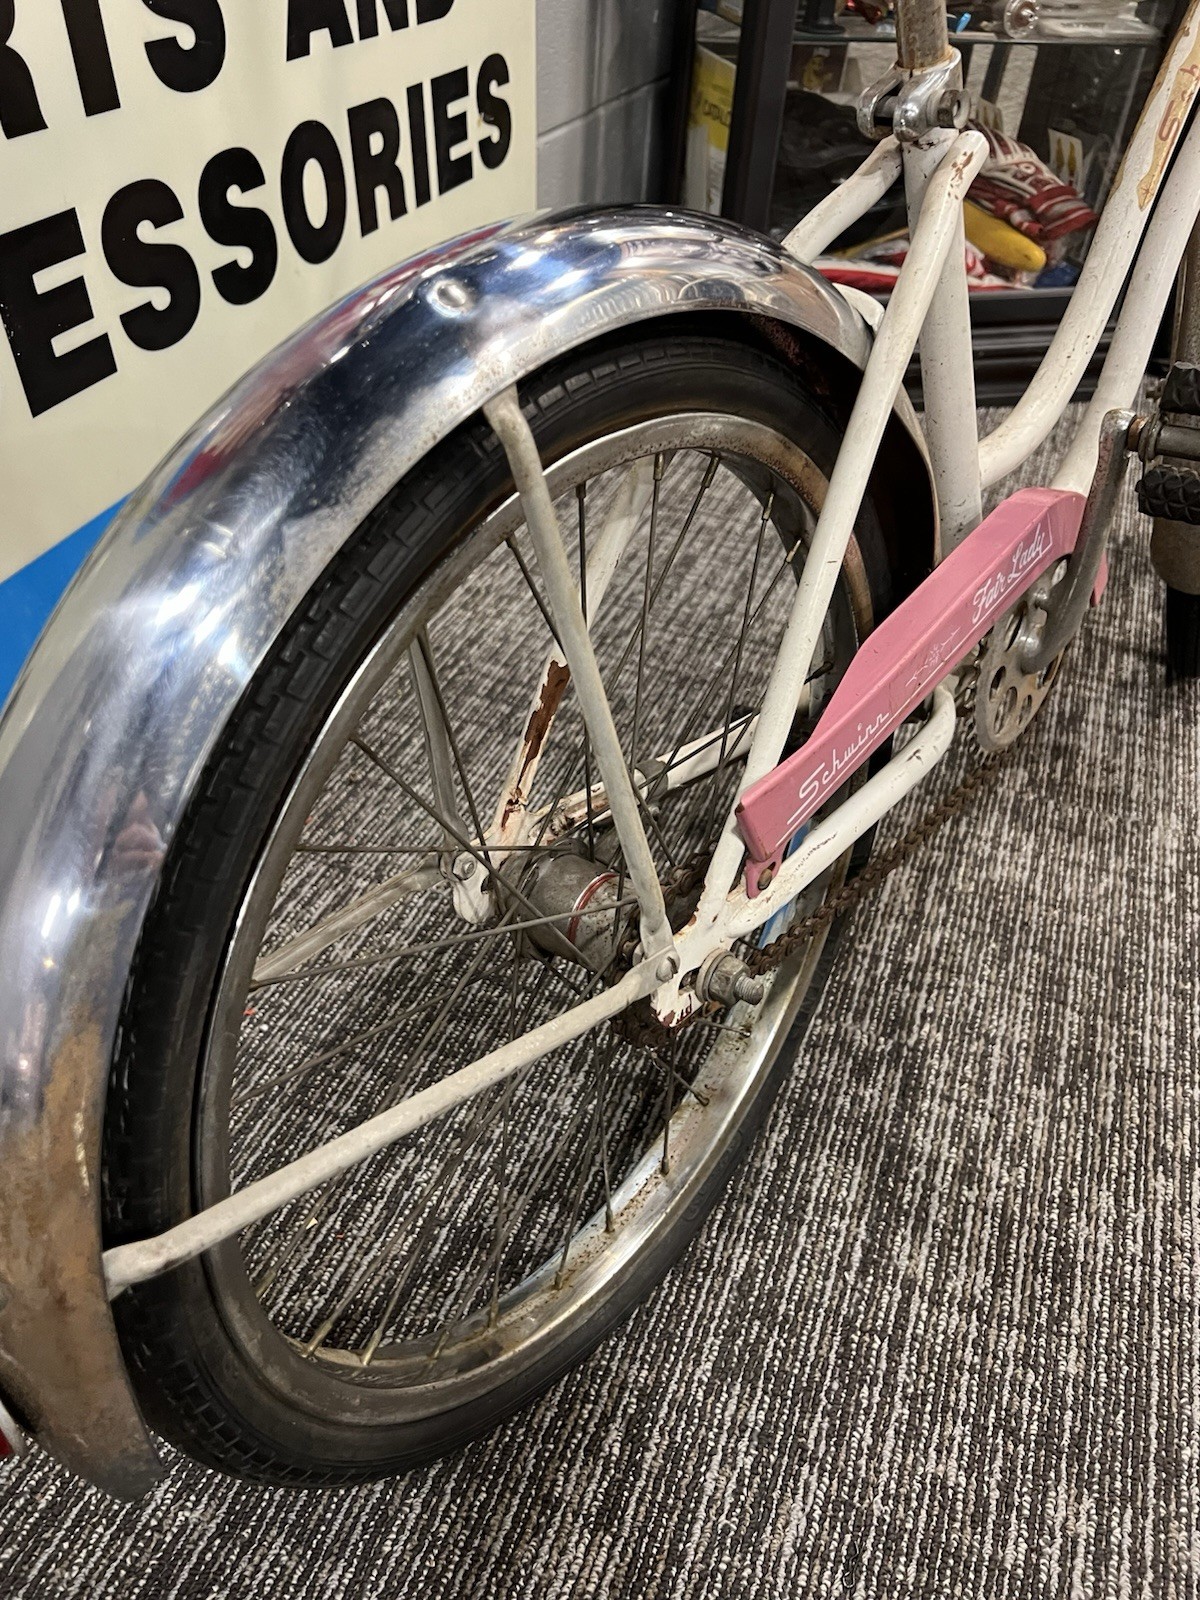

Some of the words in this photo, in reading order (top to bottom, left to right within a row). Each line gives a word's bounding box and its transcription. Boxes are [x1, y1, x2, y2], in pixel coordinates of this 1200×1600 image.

[0, 53, 512, 417] ESSORIES
[972, 572, 1005, 624] Fair
[1007, 523, 1045, 583] Lady
[787, 713, 889, 825] Schwinn
